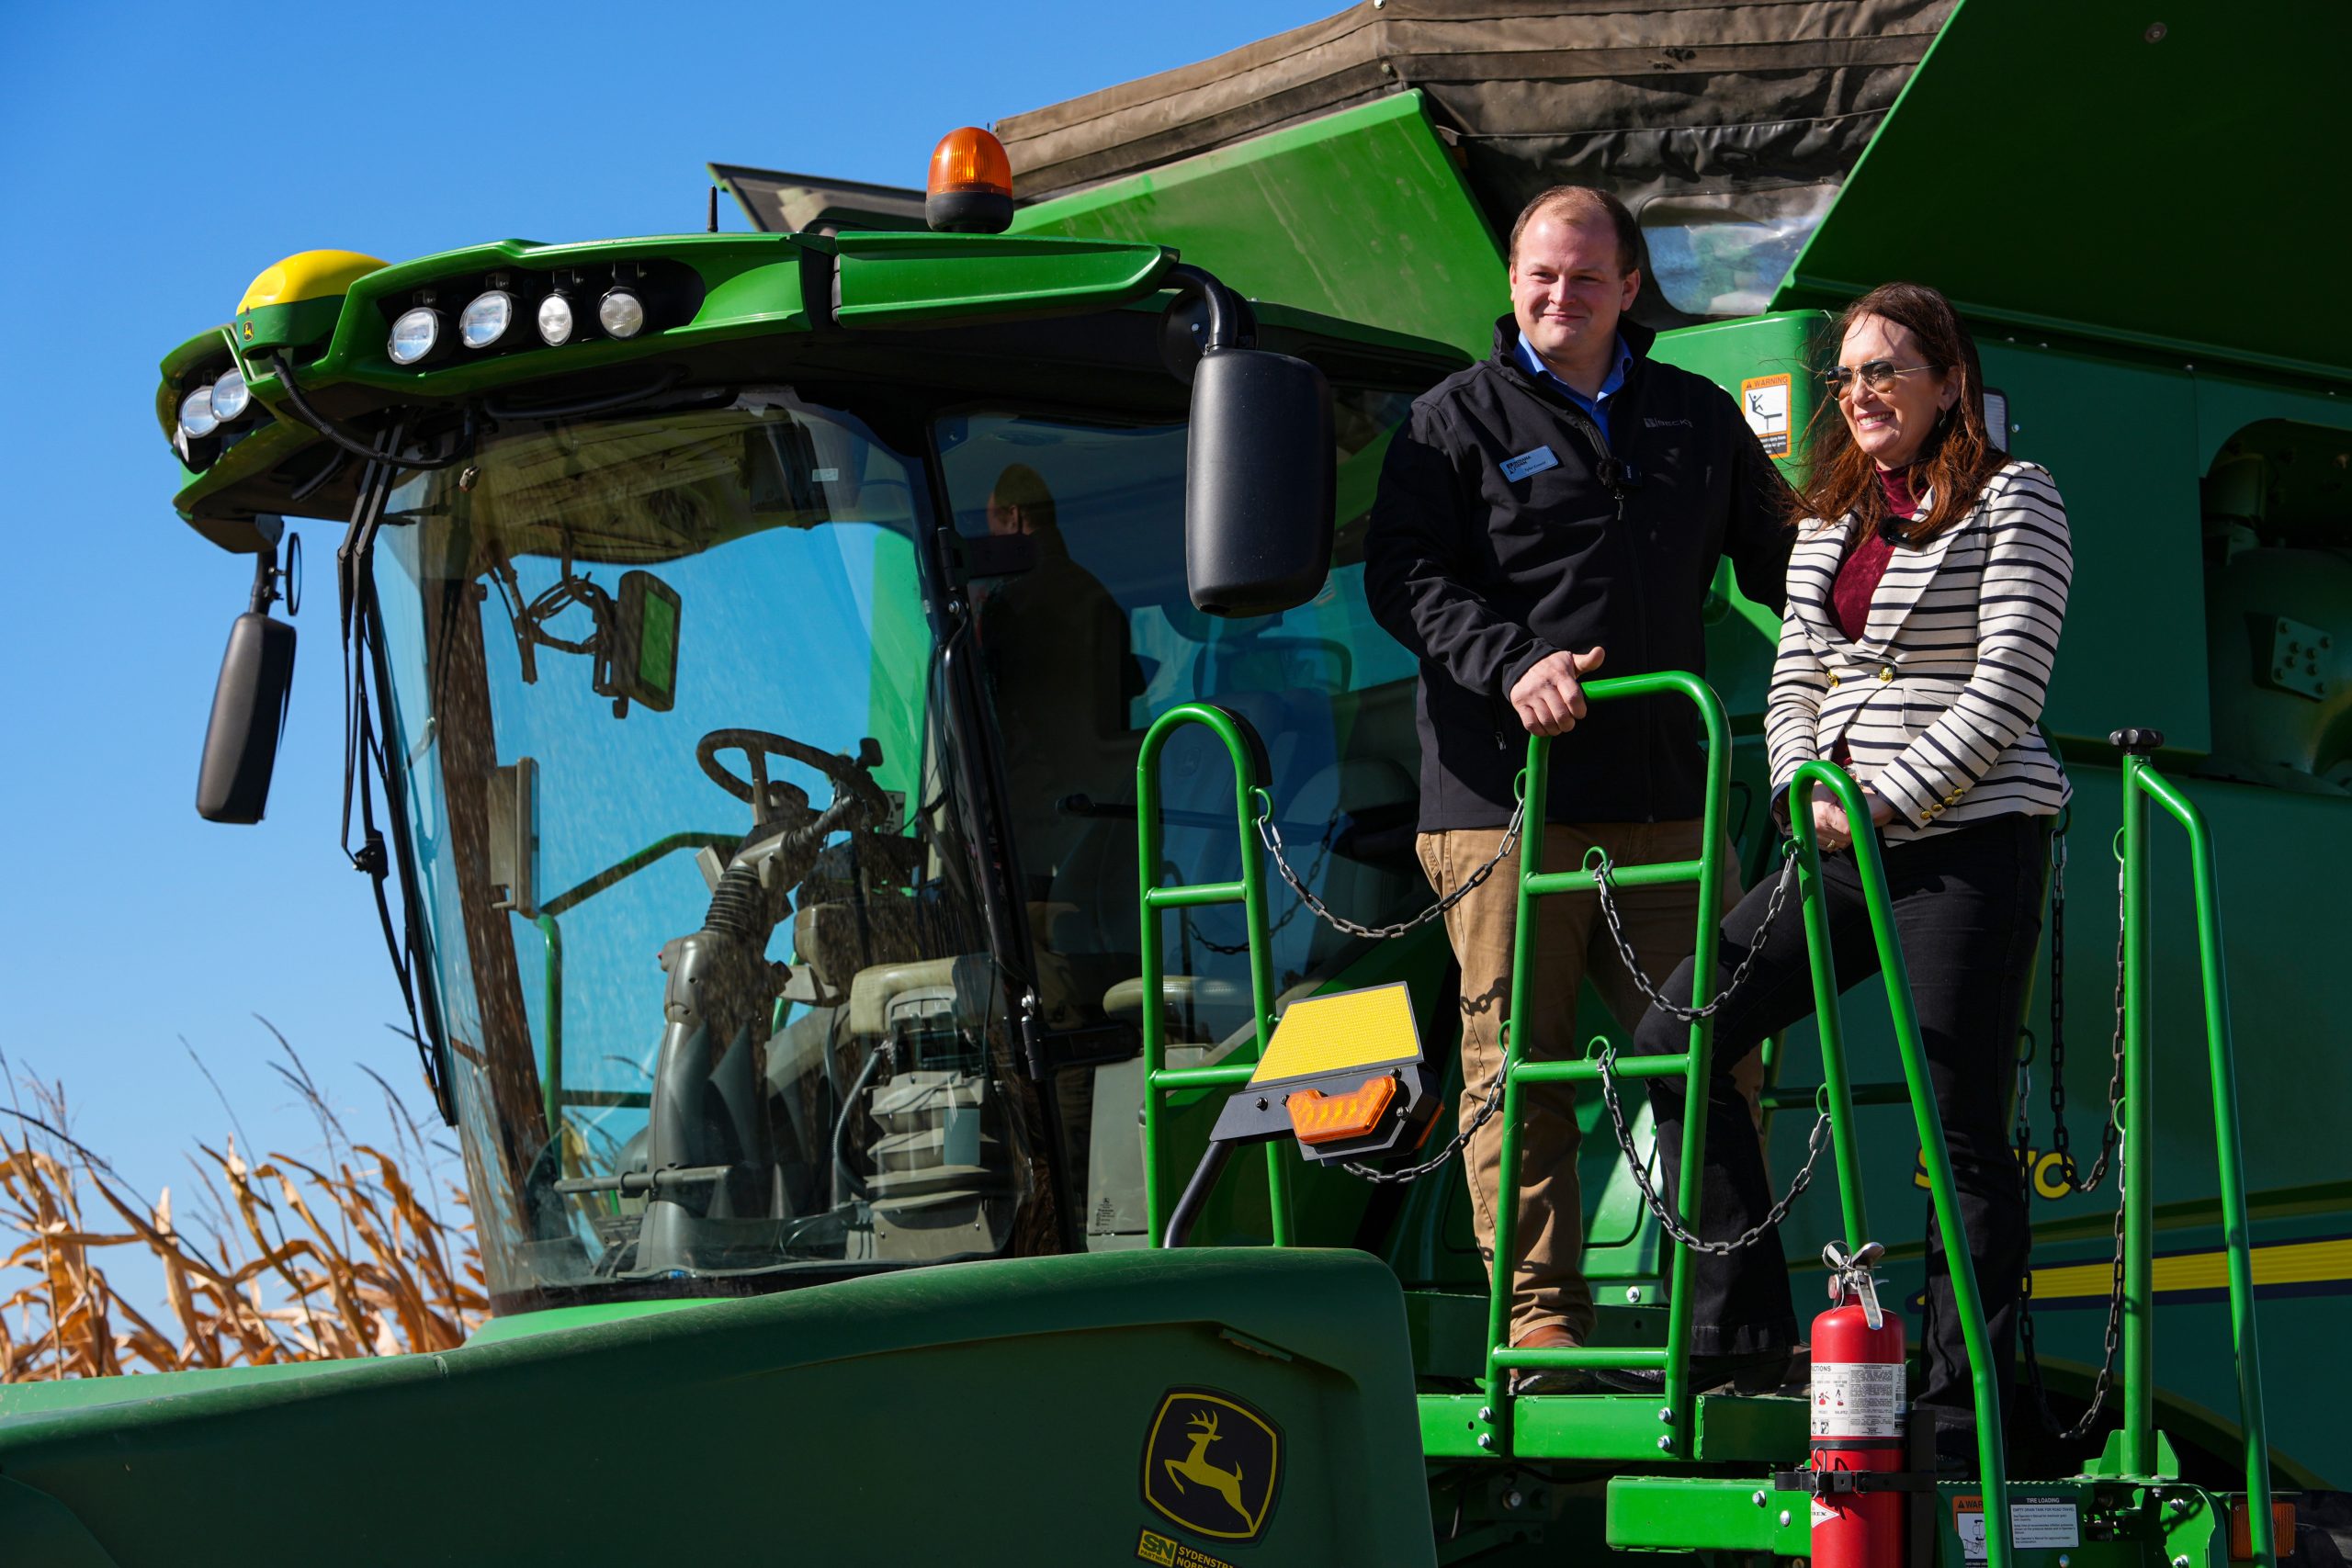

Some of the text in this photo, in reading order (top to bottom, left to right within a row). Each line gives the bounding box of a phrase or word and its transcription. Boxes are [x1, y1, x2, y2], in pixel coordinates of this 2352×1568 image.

[1754, 375, 1789, 388] WARNING
[1139, 1550, 1171, 1564] PARTNERS
[1178, 1546, 1234, 1568] SYDENSTR
